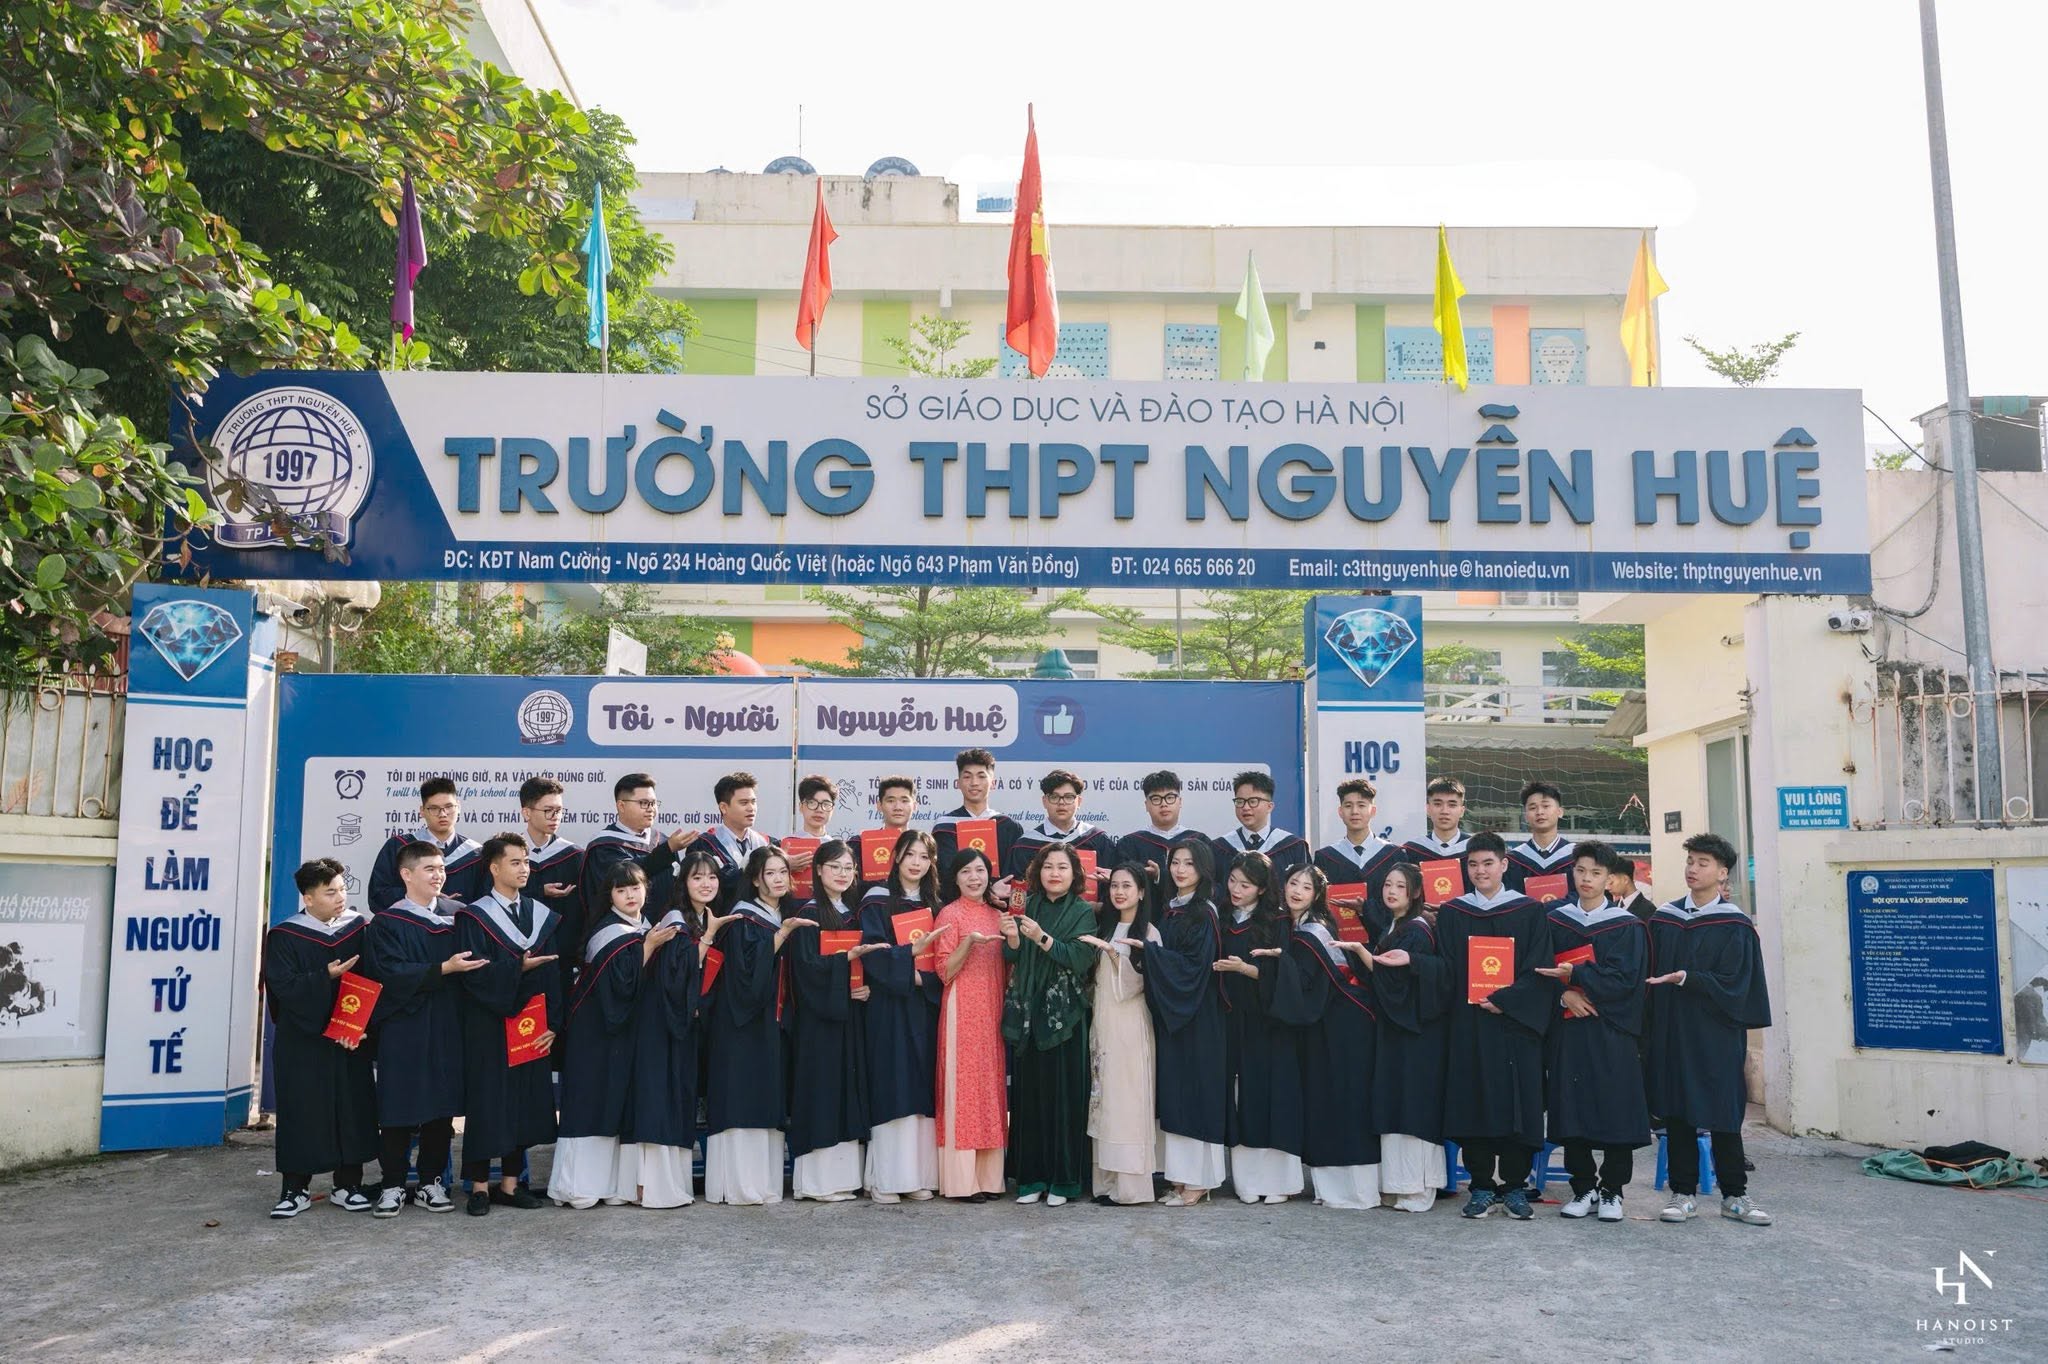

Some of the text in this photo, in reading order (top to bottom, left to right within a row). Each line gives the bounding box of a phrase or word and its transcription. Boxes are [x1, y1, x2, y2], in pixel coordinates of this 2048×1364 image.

[227, 402, 264, 436] TRƯỜNG
[266, 395, 294, 407] THPT
[298, 395, 340, 419] NGUYỄN
[866, 385, 1404, 432] SỞ GIÁO DỤC VÀ ĐÀO TẠO HÀ NỘI
[263, 449, 318, 483] 1997
[444, 403, 1822, 549] TRƯỜNG THPT NGUYỄN HUỆ
[245, 527, 264, 540] TP
[444, 549, 474, 569] ĐC:
[479, 549, 513, 569] KĐT
[518, 550, 554, 569] Nam
[559, 548, 611, 574] Cường
[627, 552, 659, 575] Ngõ
[662, 553, 690, 572] 234
[695, 553, 746, 577] Hoàng
[751, 550, 792, 576] Quốc
[796, 553, 827, 576] Việt
[831, 553, 876, 577] (hoặc
[880, 553, 913, 577] Ngõ
[916, 555, 944, 574] 643
[948, 555, 993, 577] Phạm
[997, 553, 1028, 575] Văn
[1031, 552, 1080, 579] Đồng)
[1111, 558, 1256, 576] ĐT: 024 665 666 20
[1289, 559, 1570, 582] Email: c3ttnguyenhue@hanoiedu.vn
[1612, 561, 1822, 585] Website: thptnguyenhue.vn
[536, 711, 555, 723] 1997
[602, 703, 654, 731] Tôi
[684, 704, 779, 737] Người
[817, 697, 1007, 739] Nguyễn Huệ
[153, 735, 214, 779] HỌC
[1344, 741, 1400, 780] HỌC
[387, 769, 403, 782] TÔI
[406, 771, 415, 782] ĐI
[472, 769, 492, 783] GIỜ,
[495, 772, 508, 782] RA
[512, 769, 533, 782] VÀO
[557, 770, 584, 782] ĐÚNG
[587, 770, 607, 783] GIỜ.
[926, 779, 949, 789] SINH
[1009, 777, 1022, 790] CÓ
[1027, 777, 1034, 790] Ý
[1093, 777, 1105, 792] VỆ
[1109, 777, 1129, 791] CỦA
[1188, 778, 1208, 791] SẢN
[1212, 778, 1232, 791] CỦA
[160, 783, 203, 831] ĐỂ
[393, 787, 410, 797] will
[463, 787, 478, 801] for
[480, 787, 508, 797] school
[1784, 790, 1841, 805] VUI LÒNG
[385, 810, 400, 822] TÔI
[464, 810, 478, 823] VÀ
[481, 810, 494, 823] CÓ
[498, 810, 520, 823] THÁI
[580, 810, 600, 823] TÚC
[658, 813, 680, 825] HỌC,
[684, 811, 701, 824] GIỜ
[1025, 811, 1044, 823] keep
[145, 849, 209, 891] LÀM
[126, 909, 221, 951] NGƯỜI
[151, 966, 192, 1013] TỬ
[149, 1027, 187, 1075] TẾ
